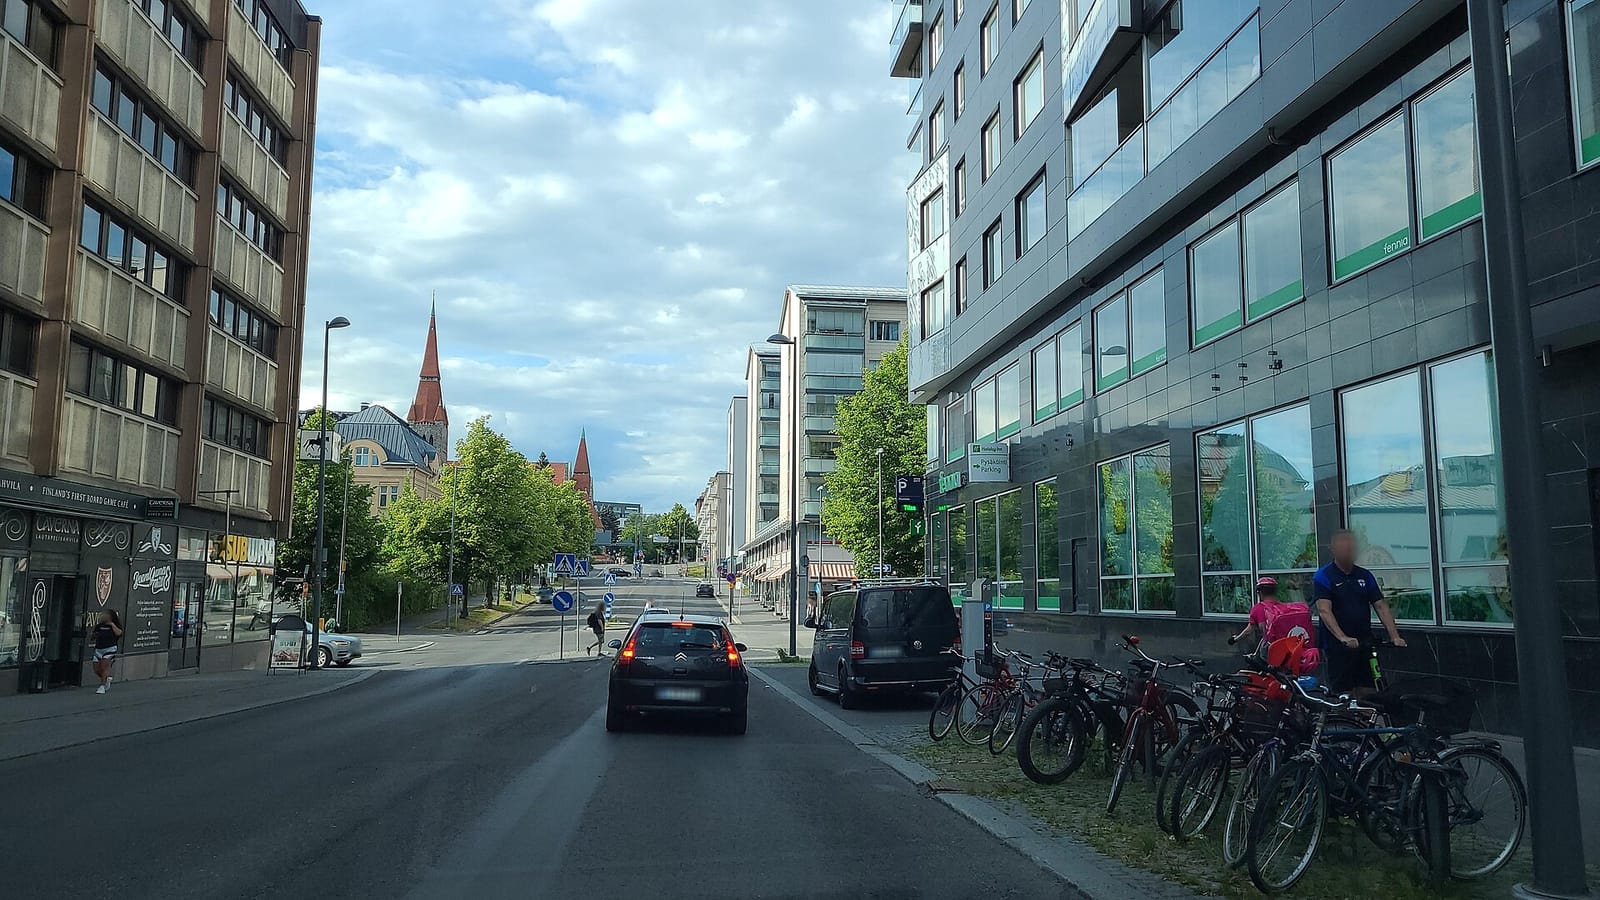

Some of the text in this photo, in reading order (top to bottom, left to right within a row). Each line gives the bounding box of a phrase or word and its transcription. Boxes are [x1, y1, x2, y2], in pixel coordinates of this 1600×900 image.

[1383, 236, 1408, 255] fennia
[42, 486, 129, 509] FINLAND'S FIRST BOARD GAME CAFÉ
[898, 481, 908, 494] P
[227, 534, 276, 566] SUBWAY
